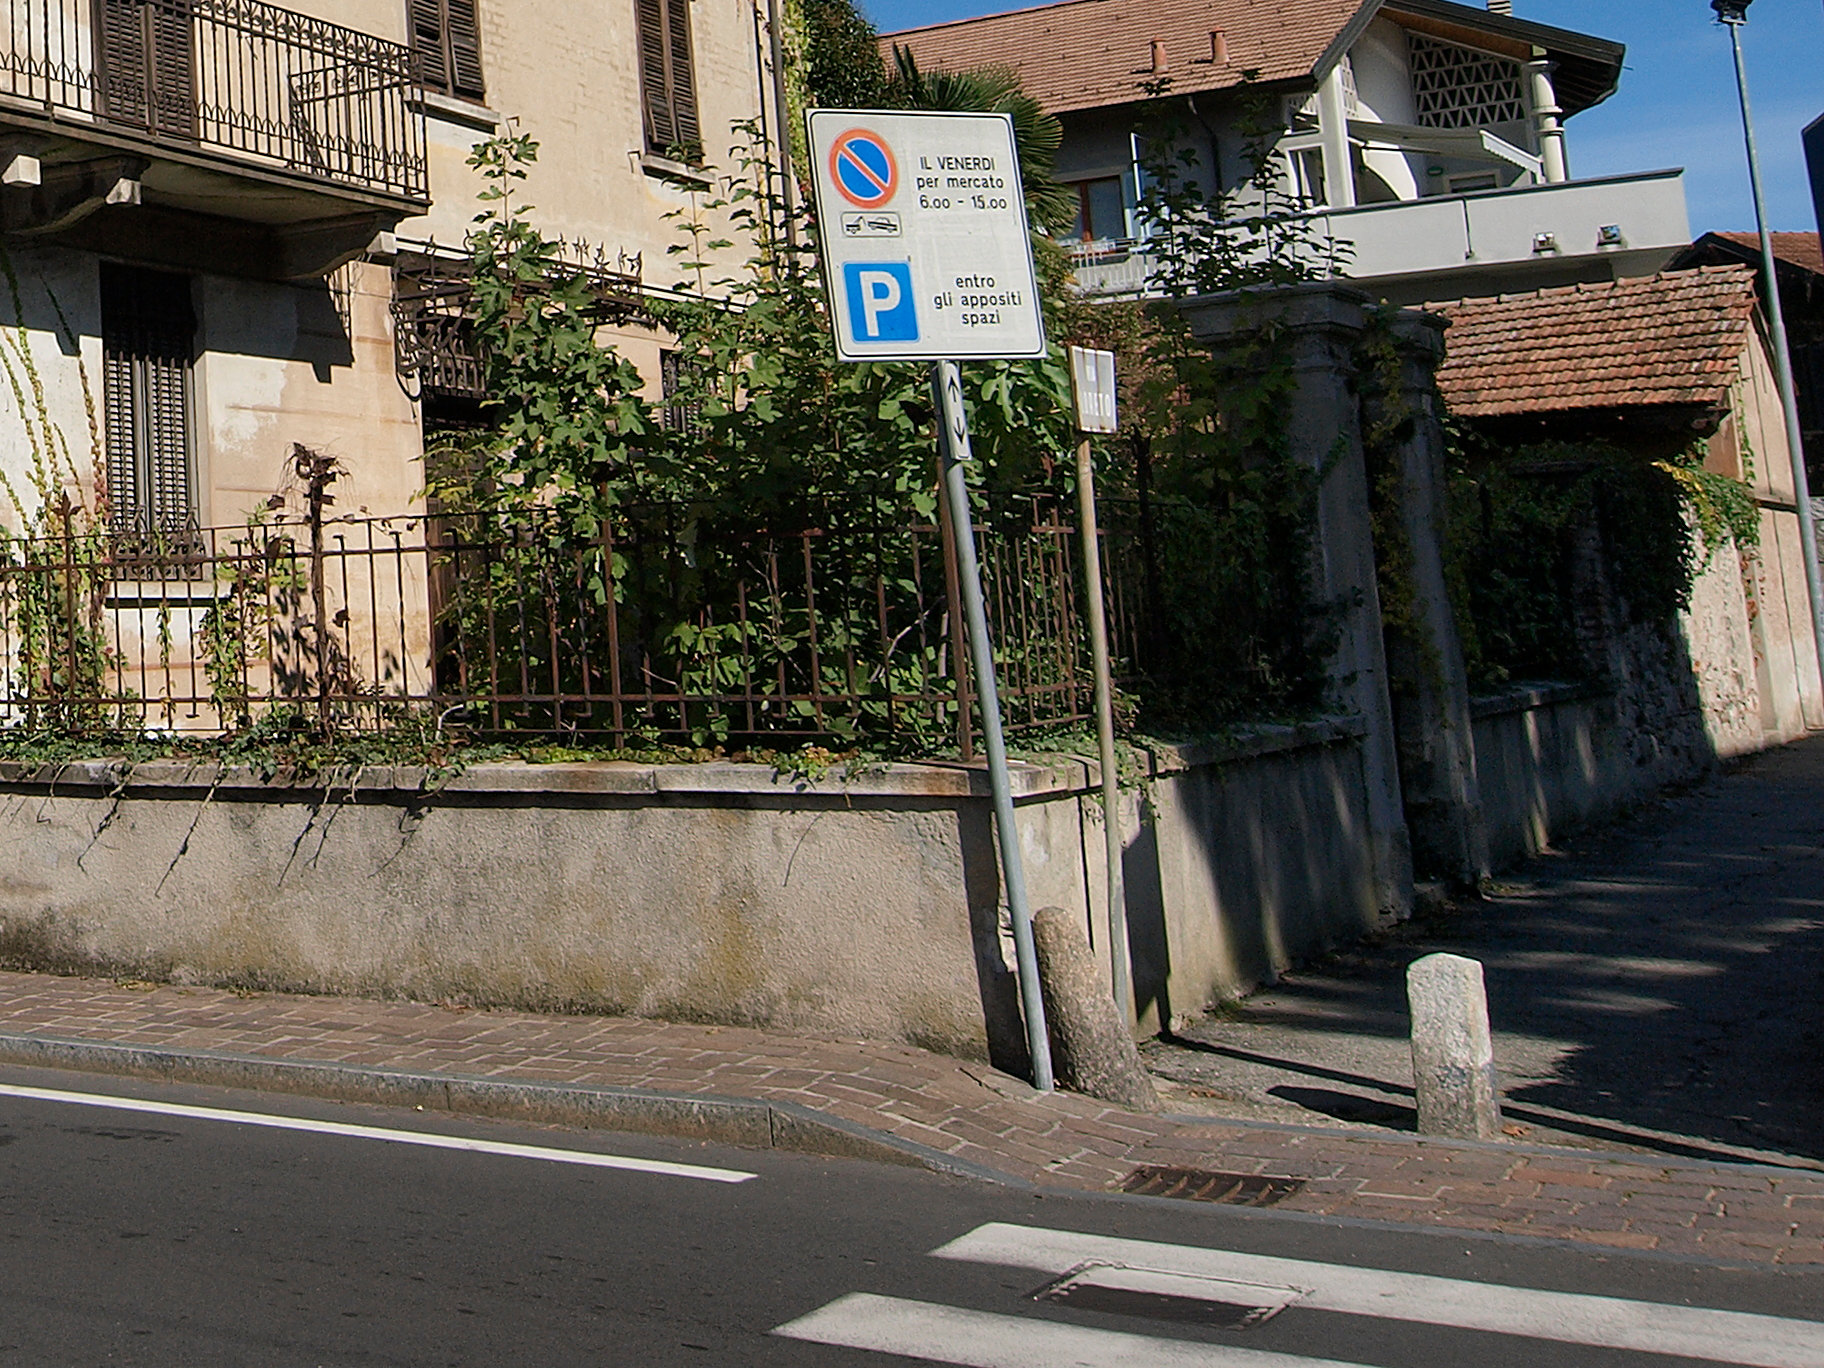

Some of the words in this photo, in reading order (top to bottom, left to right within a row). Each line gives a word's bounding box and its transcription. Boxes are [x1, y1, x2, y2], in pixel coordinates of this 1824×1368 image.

[920, 156, 932, 170] IL
[937, 156, 996, 171] VENERDI
[916, 177, 939, 190] per
[946, 174, 1004, 189] mercato
[919, 194, 951, 209] 6.00
[971, 193, 1007, 210] 15.00
[955, 274, 996, 288] entro
[859, 271, 901, 337] P
[933, 292, 953, 309] gli
[961, 291, 1022, 309] appositi
[962, 309, 1001, 327] spazi
